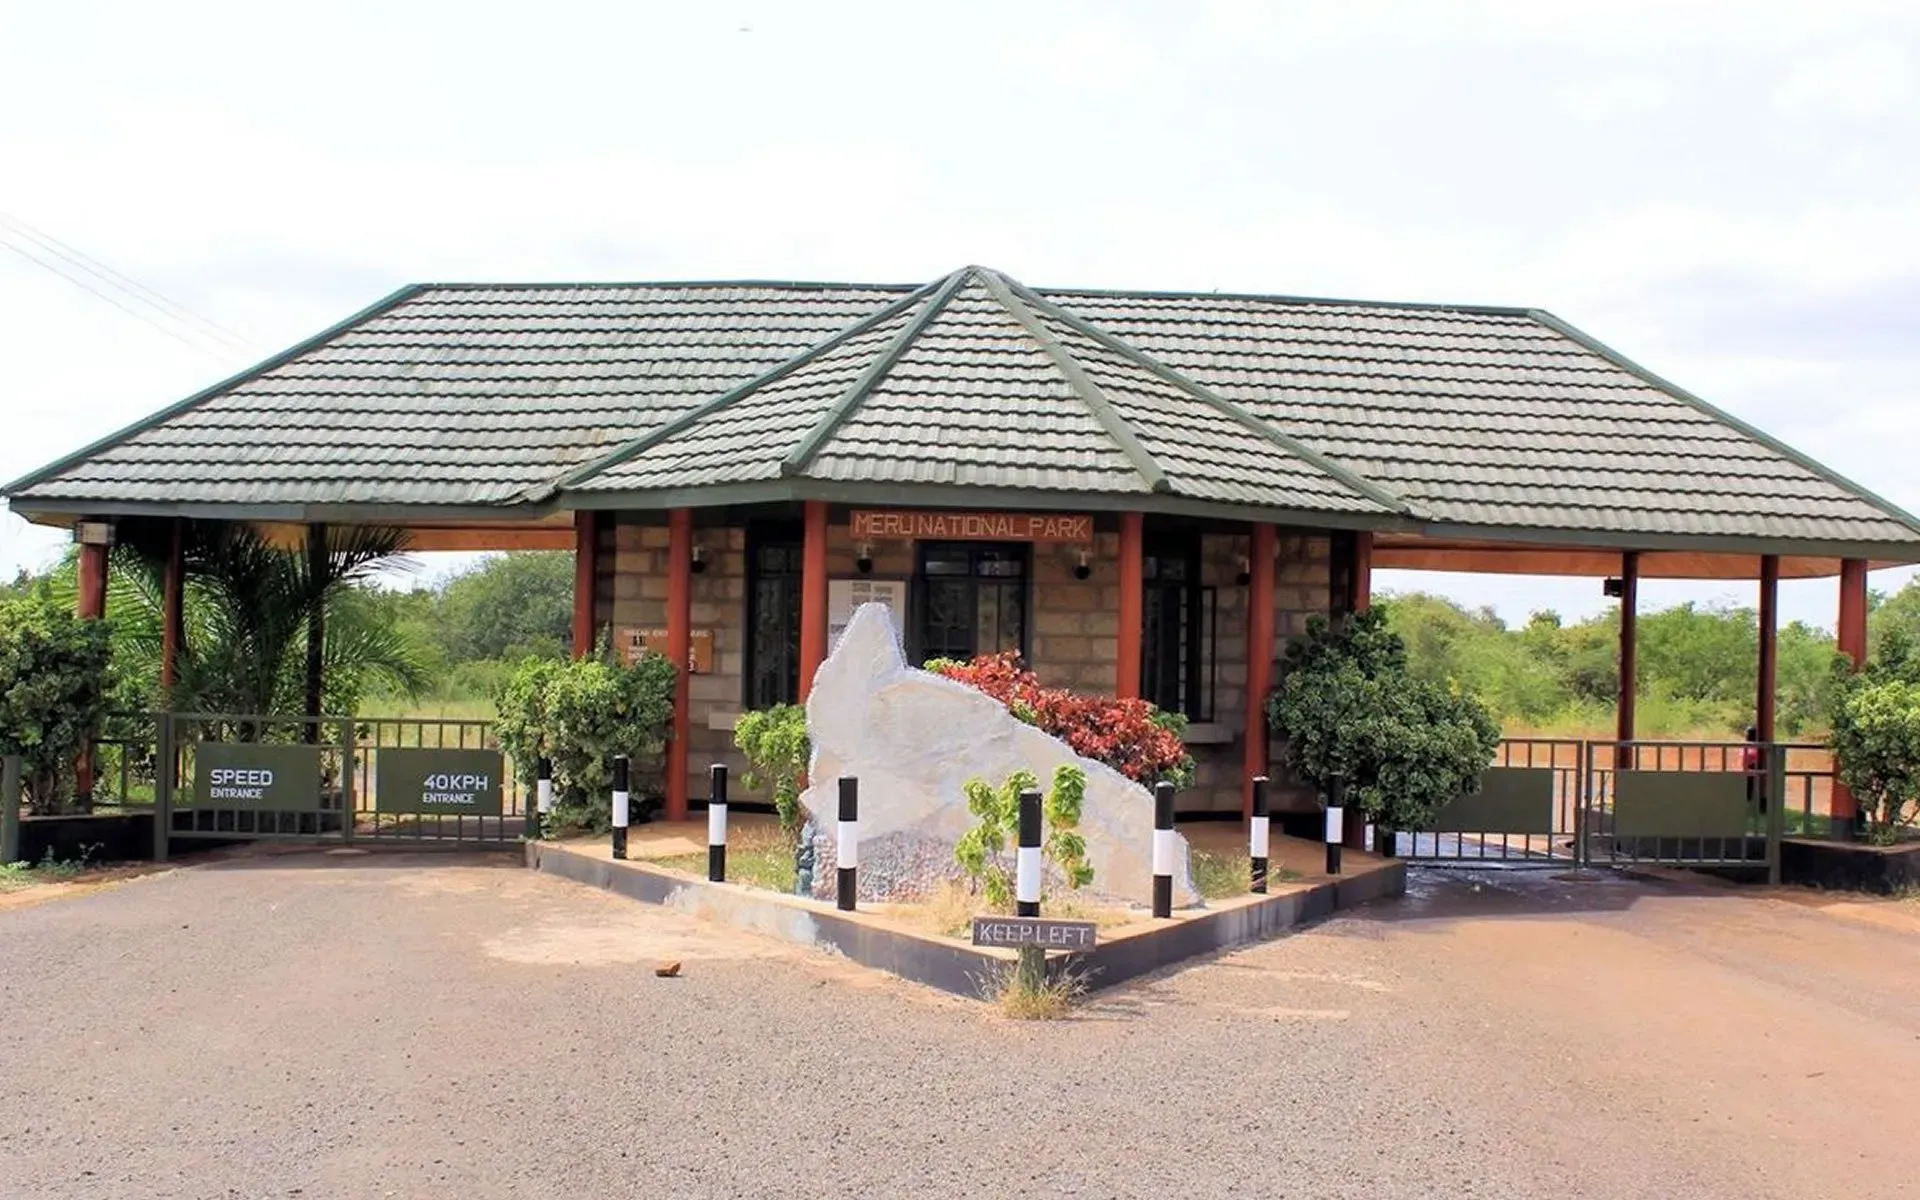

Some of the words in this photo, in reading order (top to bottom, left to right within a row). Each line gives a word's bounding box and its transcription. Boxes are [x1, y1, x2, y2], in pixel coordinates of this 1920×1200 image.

[855, 513, 914, 535] MERU
[918, 515, 1025, 537] NATIONAL
[1028, 518, 1087, 538] PARK
[210, 769, 273, 786] SPEED
[423, 773, 488, 790] 40KPH
[210, 787, 263, 799] ENTRANCE
[423, 792, 475, 804] ENTRANCE
[980, 923, 1032, 942] KEEP
[1036, 925, 1090, 944] LEFT
